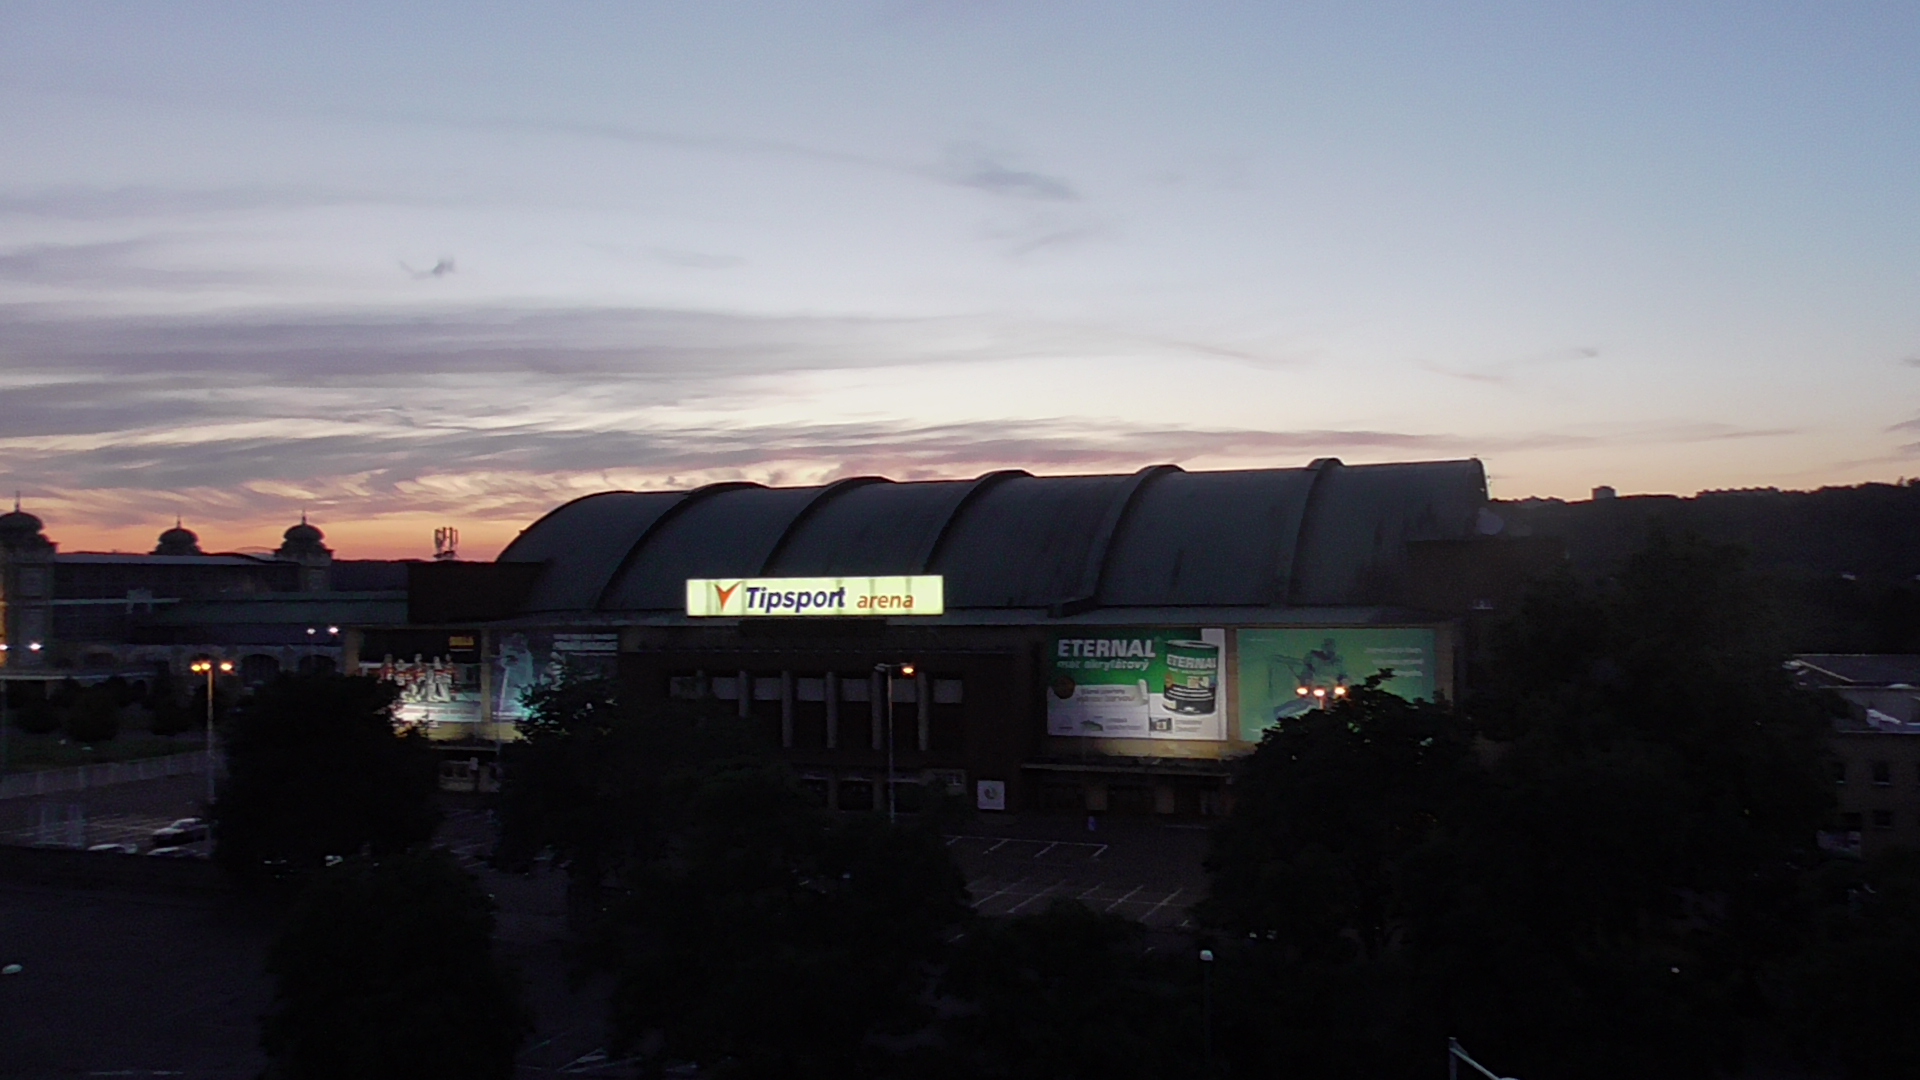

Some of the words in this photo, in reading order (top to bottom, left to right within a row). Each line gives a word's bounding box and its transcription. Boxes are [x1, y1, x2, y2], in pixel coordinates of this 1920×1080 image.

[746, 586, 845, 613] Tipsport
[857, 593, 914, 609] arena
[1057, 639, 1156, 658] ETERNAL
